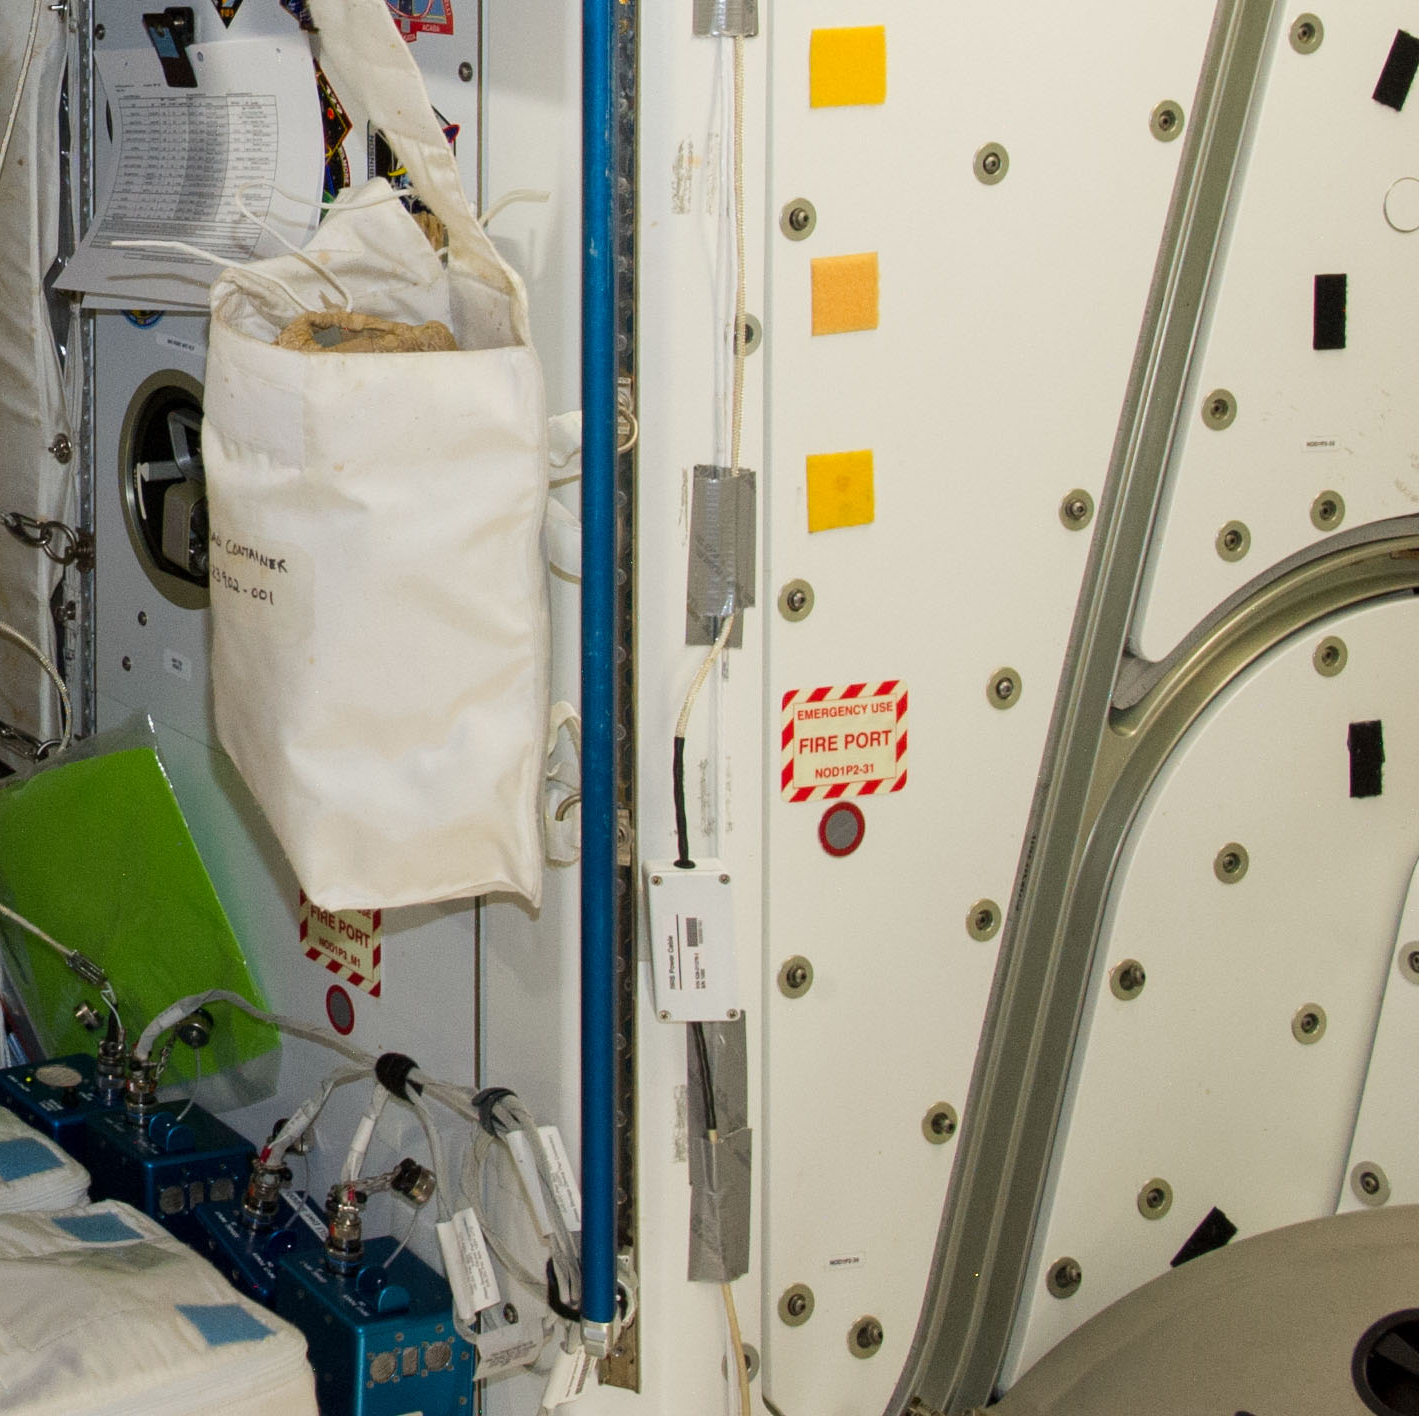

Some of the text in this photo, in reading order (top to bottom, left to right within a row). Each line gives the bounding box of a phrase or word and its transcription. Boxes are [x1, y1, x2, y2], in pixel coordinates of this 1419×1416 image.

[225, 539, 289, 575] CONTAINER
[797, 701, 893, 721] EMERGENCY USE
[798, 730, 892, 755] FIRE PORT
[814, 764, 875, 779] NOD1P2-31
[310, 904, 371, 949] FIRE PORT
[668, 954, 676, 975] Power
